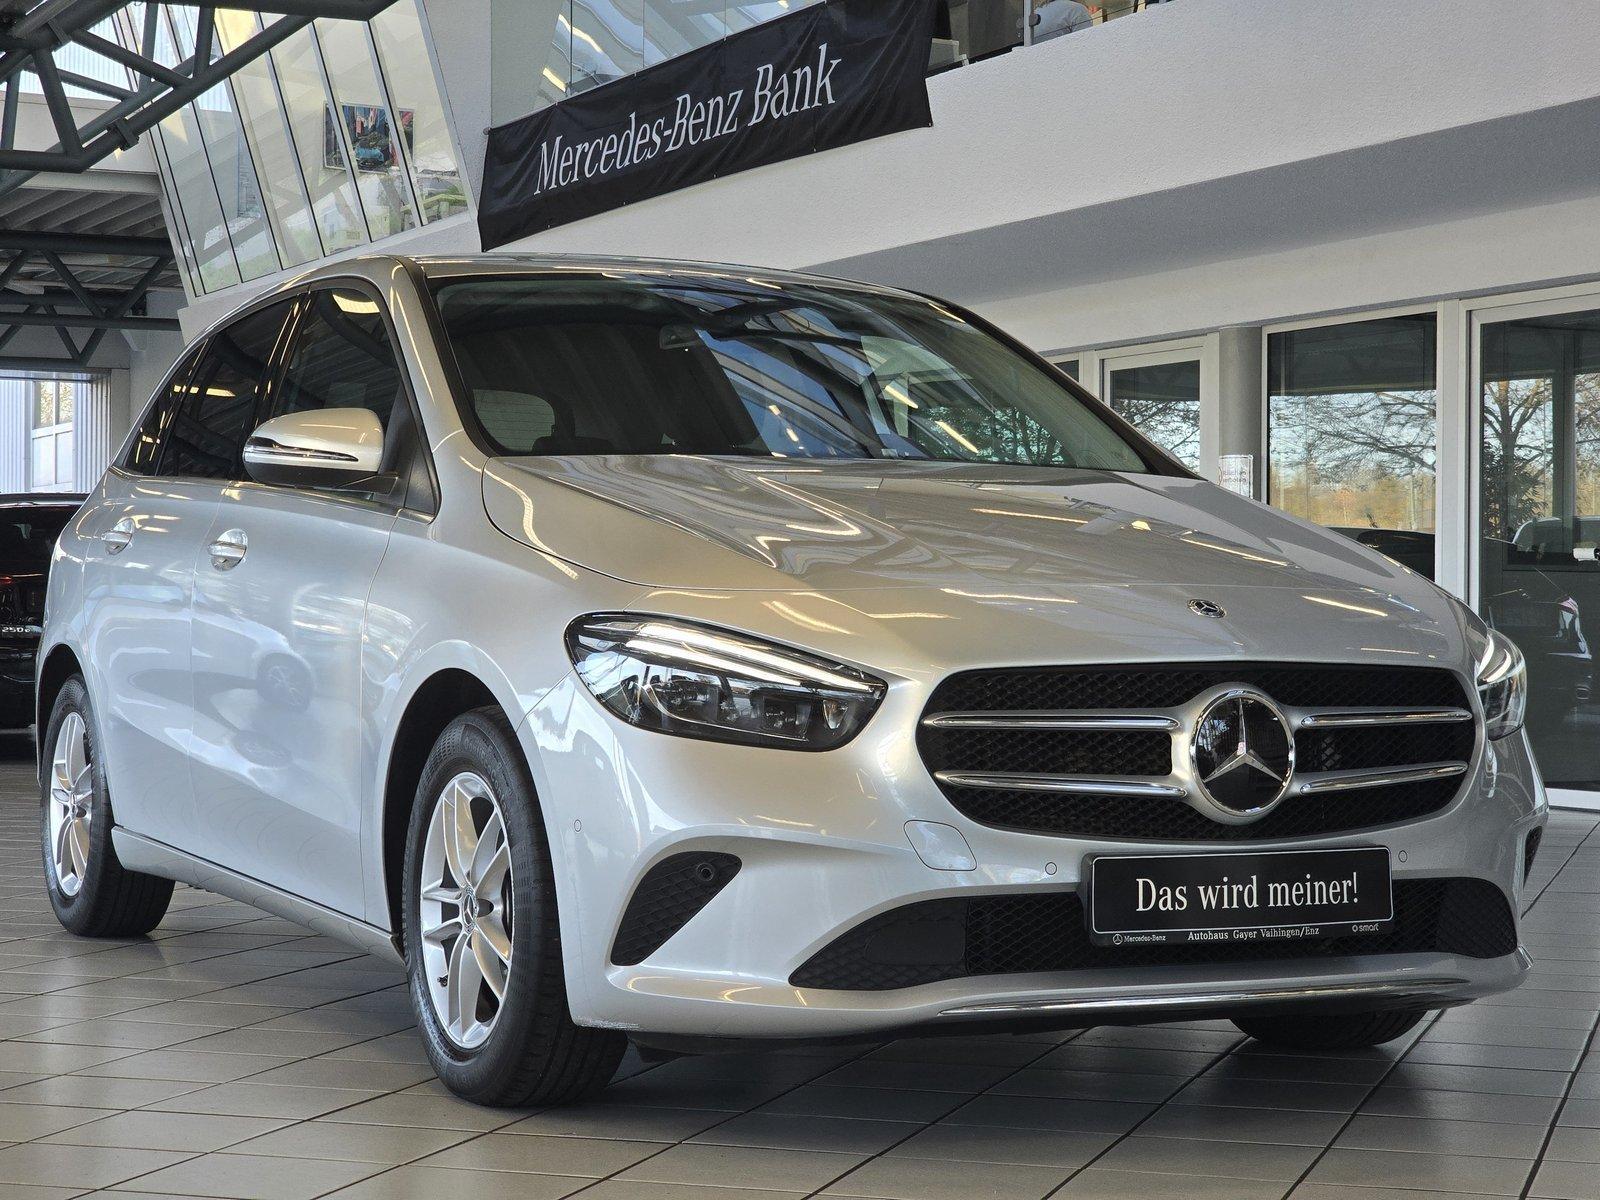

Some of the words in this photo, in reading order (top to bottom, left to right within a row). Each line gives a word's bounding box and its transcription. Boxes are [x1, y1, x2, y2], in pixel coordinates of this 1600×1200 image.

[534, 89, 743, 195] Mercedes-Benz
[747, 42, 842, 127] Bank
[1135, 877, 1188, 912] Das
[1198, 875, 1259, 910] wird
[1267, 871, 1359, 907] meiner!
[1187, 930, 1229, 941] Autohaus
[1232, 929, 1257, 941] Gayer
[1260, 926, 1320, 938] Vaihingen/Enz
[1358, 922, 1380, 932] smart
[1123, 934, 1166, 943] Mercedes-Benz
